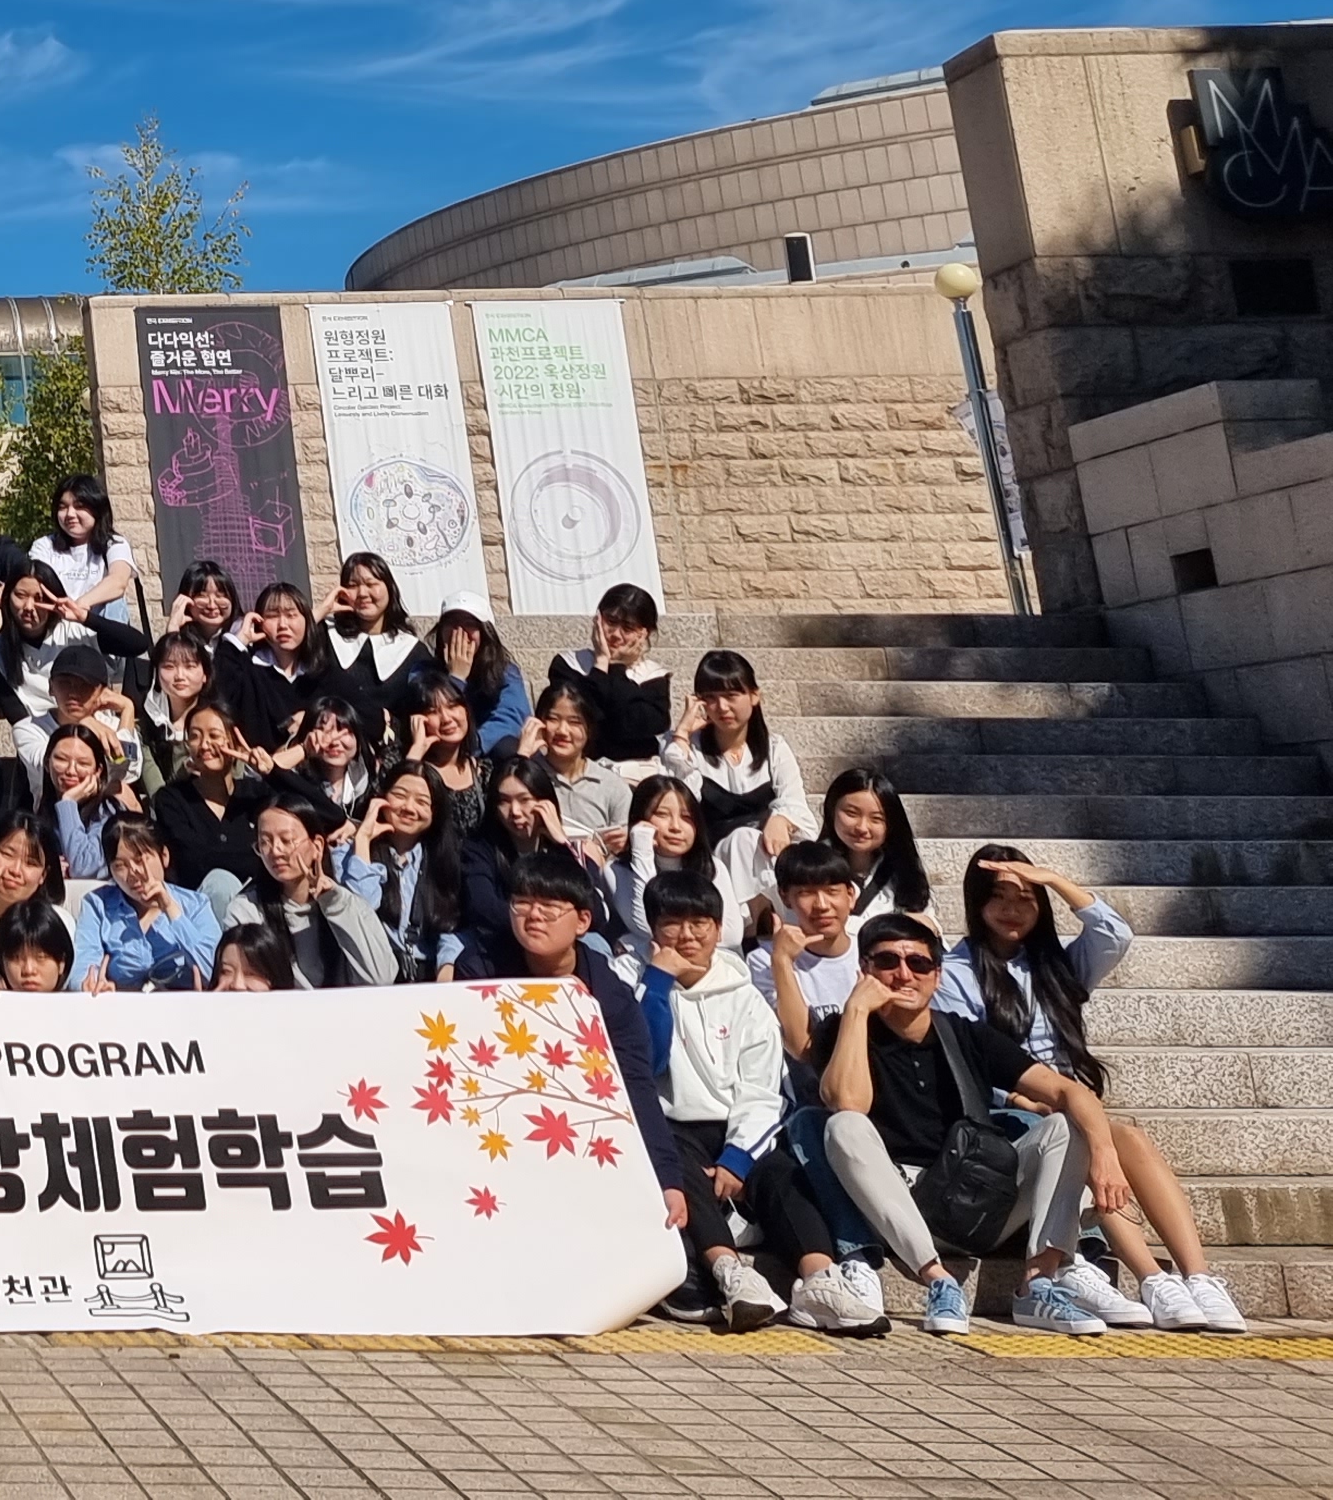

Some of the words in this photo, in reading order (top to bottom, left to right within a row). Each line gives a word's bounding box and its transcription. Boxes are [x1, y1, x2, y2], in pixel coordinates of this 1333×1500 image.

[147, 331, 215, 349] 다다익선:
[324, 329, 386, 346] 원형정원
[488, 328, 548, 343] MMCA
[150, 350, 197, 367] 즐거운
[200, 349, 232, 367] 협연
[327, 348, 393, 363] 프로젝트:
[490, 345, 584, 362] 과천프로젝트
[493, 365, 539, 380] 2022:
[544, 364, 607, 380] 옥상정원
[152, 378, 279, 422] Merry
[332, 385, 379, 401] 느리고
[382, 384, 414, 401] 빠른
[417, 383, 449, 400] 대화
